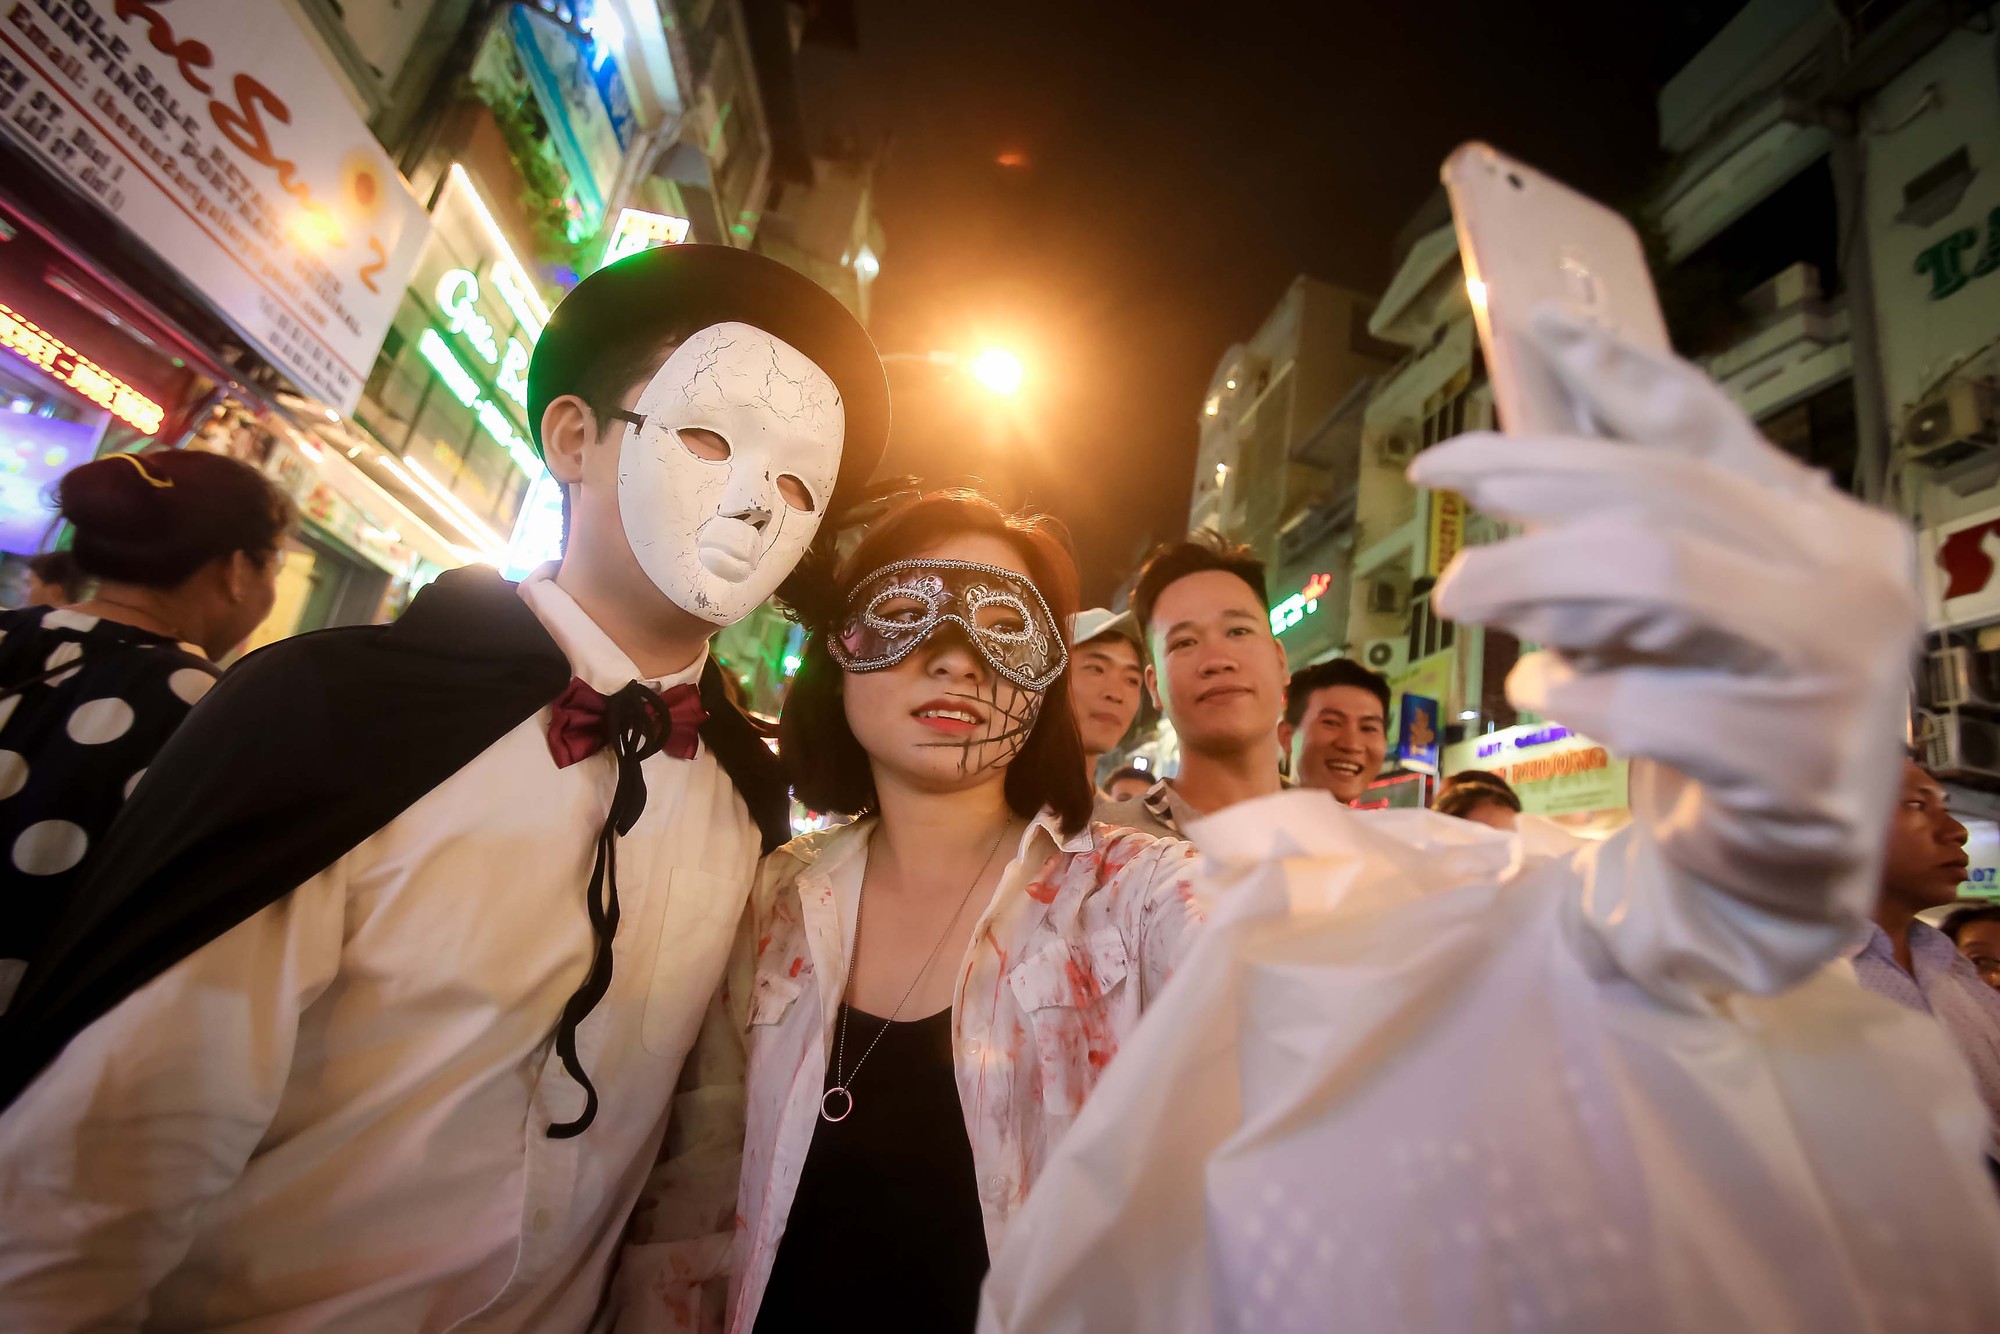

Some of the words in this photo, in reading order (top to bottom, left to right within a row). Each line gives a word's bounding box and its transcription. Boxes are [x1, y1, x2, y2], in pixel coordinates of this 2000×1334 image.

[6, 1, 89, 90] Email:
[70, 0, 131, 62] OLE
[113, 0, 214, 97] he
[358, 234, 387, 296] 2
